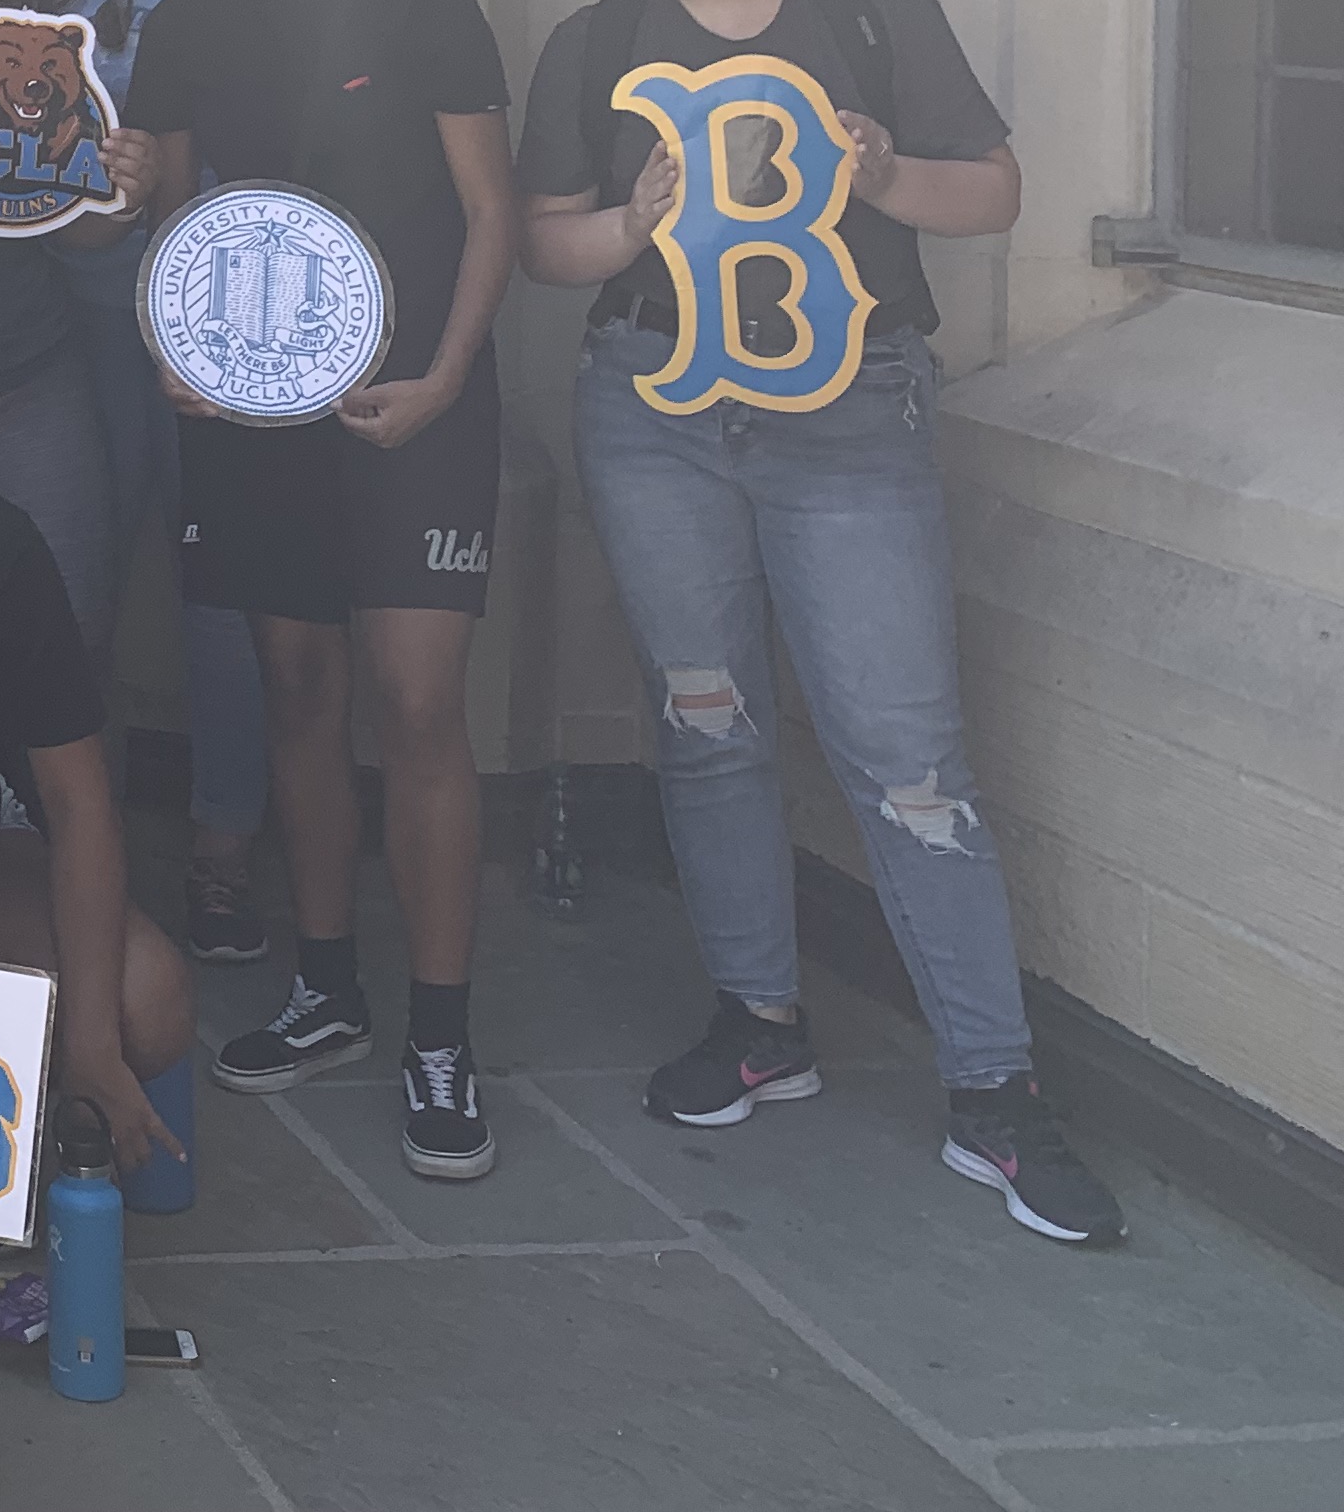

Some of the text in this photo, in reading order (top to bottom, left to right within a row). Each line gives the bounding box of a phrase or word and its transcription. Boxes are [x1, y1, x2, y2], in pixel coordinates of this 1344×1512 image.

[610, 53, 879, 416] B
[164, 204, 366, 376] THE UNIVERSITY OF CALIFORNIA
[217, 322, 326, 371] LET THERE BE LIGHT
[230, 379, 291, 401] UCLA
[423, 528, 489, 573] Ucla
